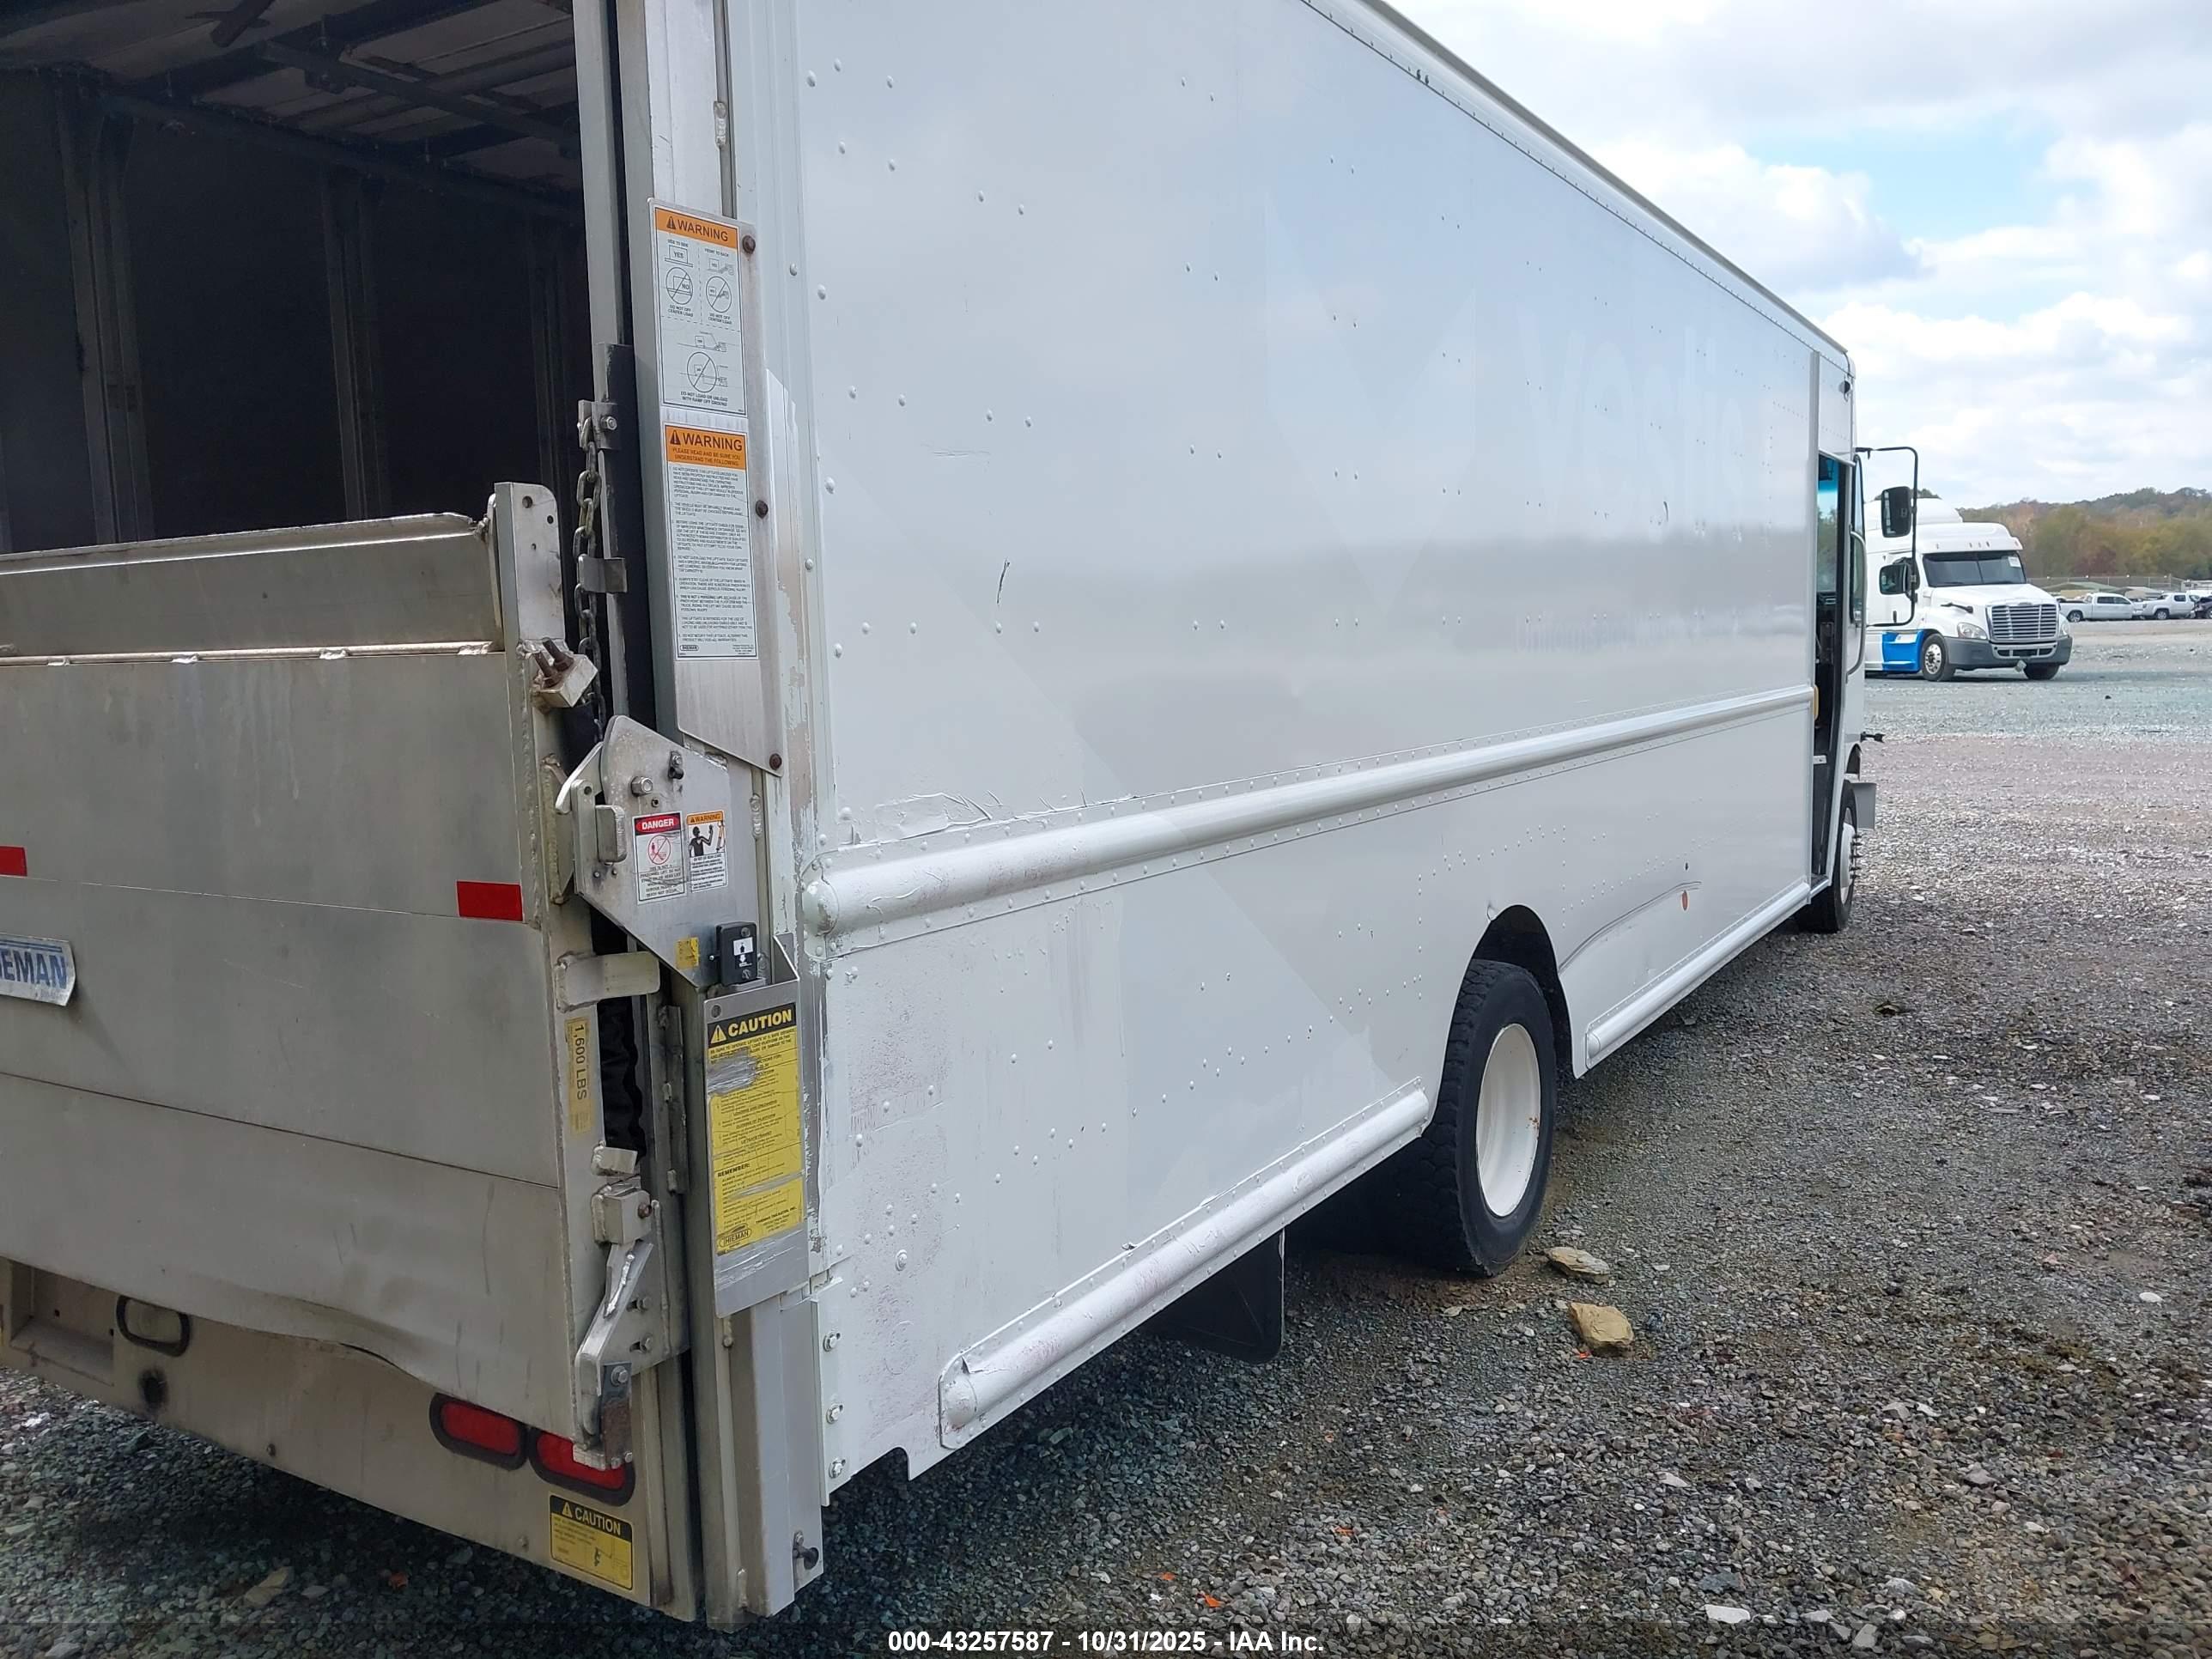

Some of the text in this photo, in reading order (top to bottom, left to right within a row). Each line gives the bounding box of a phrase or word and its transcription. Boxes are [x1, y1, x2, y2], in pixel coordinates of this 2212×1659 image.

[678, 219, 728, 241] WARNING
[683, 433, 742, 452] WARNING
[641, 818, 674, 830] DANGER
[728, 1009, 792, 1037] CAUTION
[574, 1024, 587, 1100] 1,600 LBS
[717, 1163, 750, 1177] REMEMBER:
[575, 1508, 621, 1535] CAUTION
